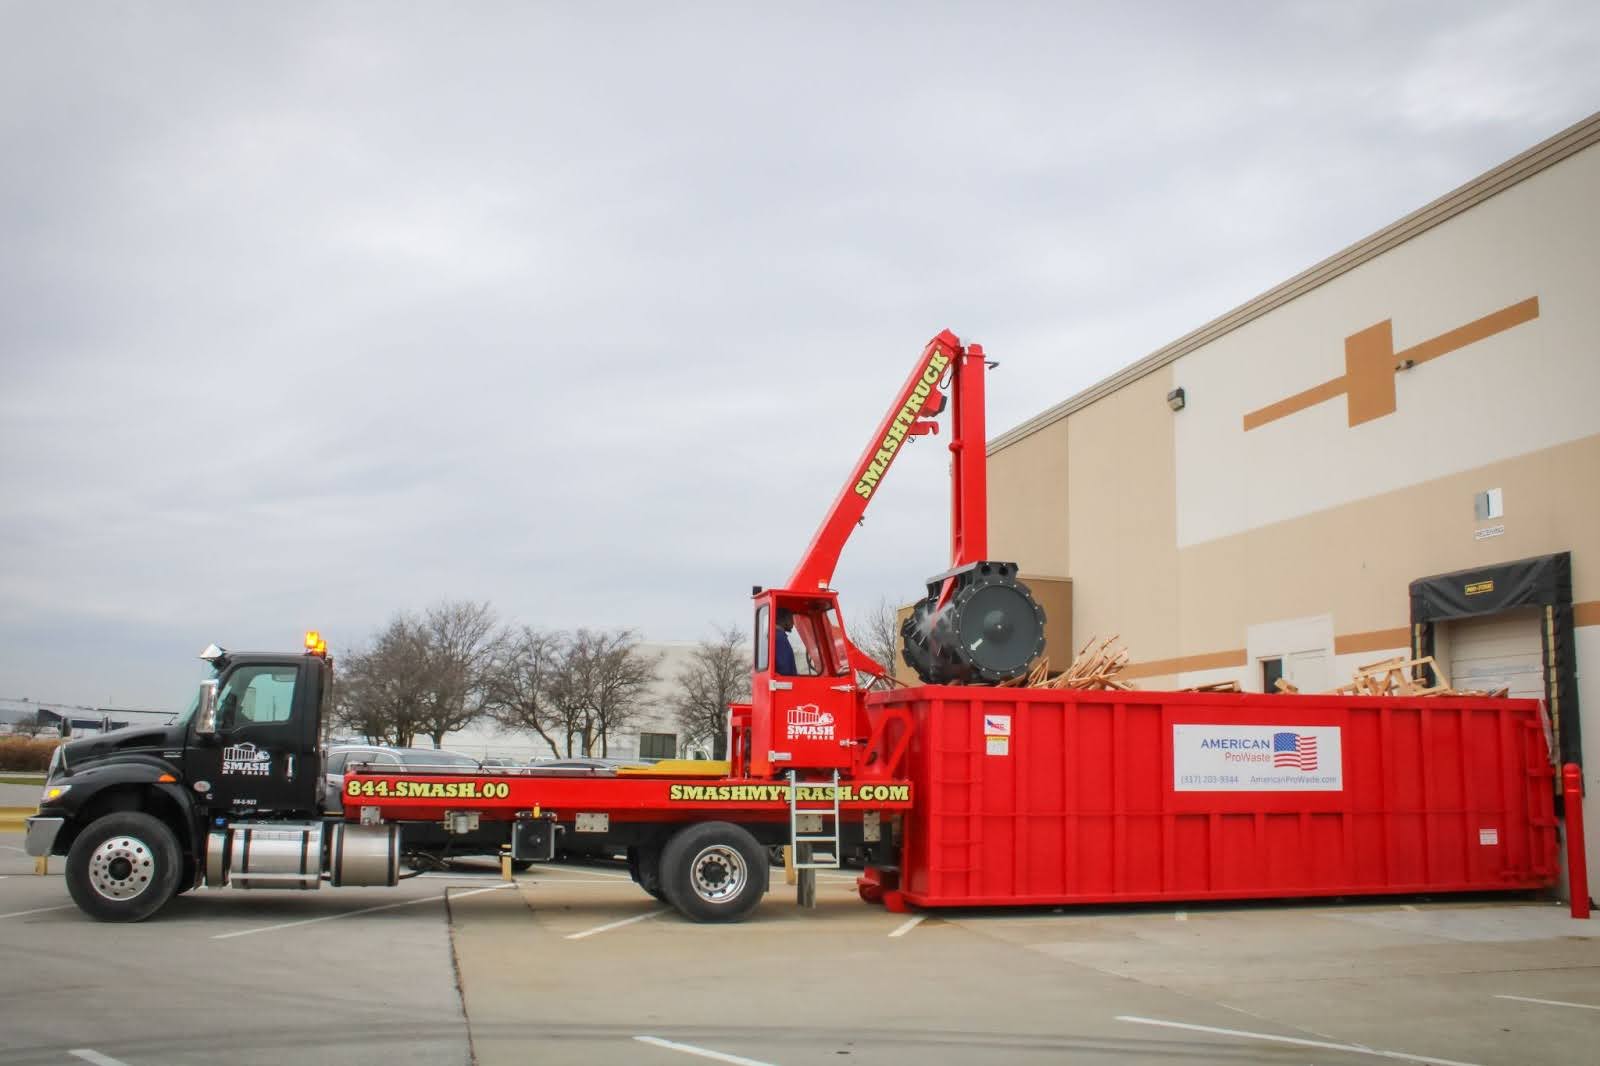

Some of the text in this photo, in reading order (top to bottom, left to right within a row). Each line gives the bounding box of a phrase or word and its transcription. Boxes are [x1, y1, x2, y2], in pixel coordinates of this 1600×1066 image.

[854, 349, 949, 499] SMASHTRUCK
[788, 725, 834, 735] SMASH
[1201, 738, 1270, 749] AMERICAN
[1225, 752, 1271, 762] ProWaste
[223, 761, 270, 770] SMASH
[348, 780, 509, 798] 844.SMASH.00
[670, 784, 909, 801] SMASHMYTRASH.COM
